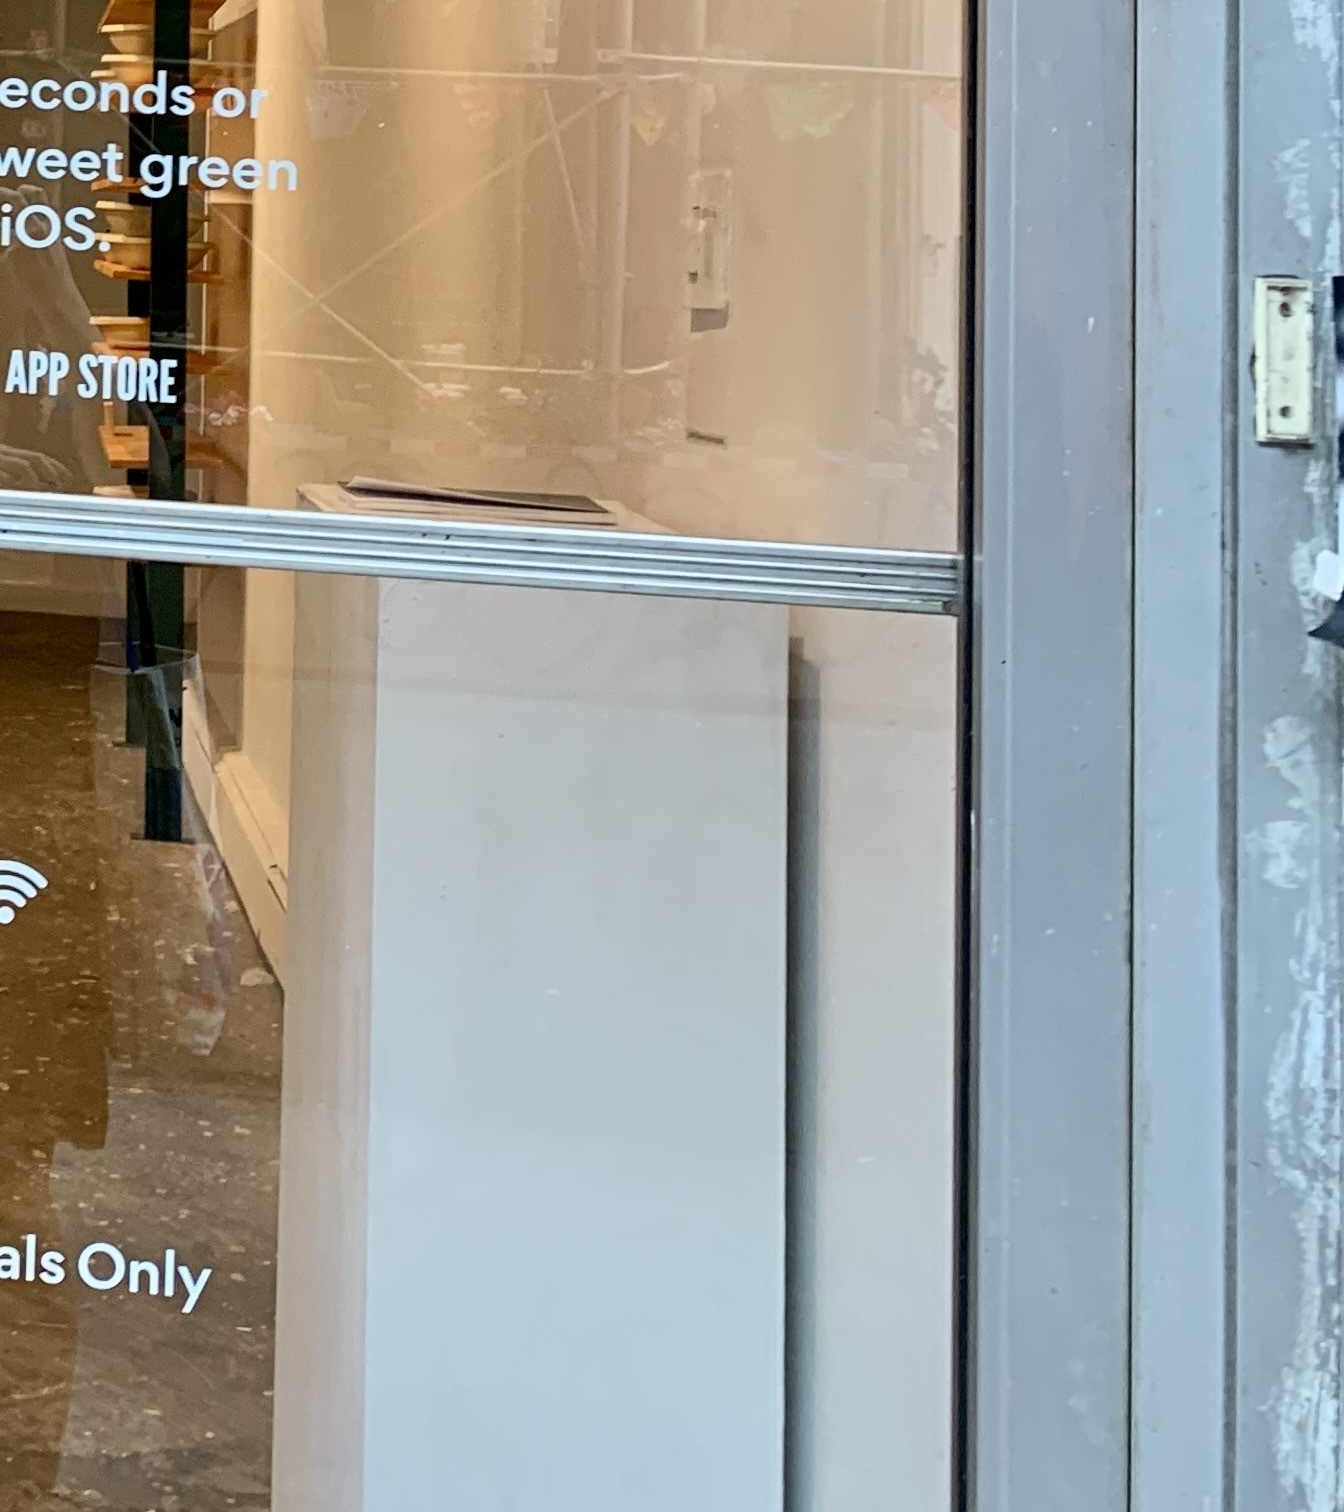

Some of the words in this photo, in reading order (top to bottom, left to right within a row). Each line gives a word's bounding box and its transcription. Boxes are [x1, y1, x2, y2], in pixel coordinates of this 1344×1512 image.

[212, 87, 269, 118] or
[139, 153, 297, 199] green
[0, 203, 109, 252] iOS.
[4, 348, 71, 396] APP
[76, 353, 179, 405] STORE
[76, 1241, 213, 1314] Only
